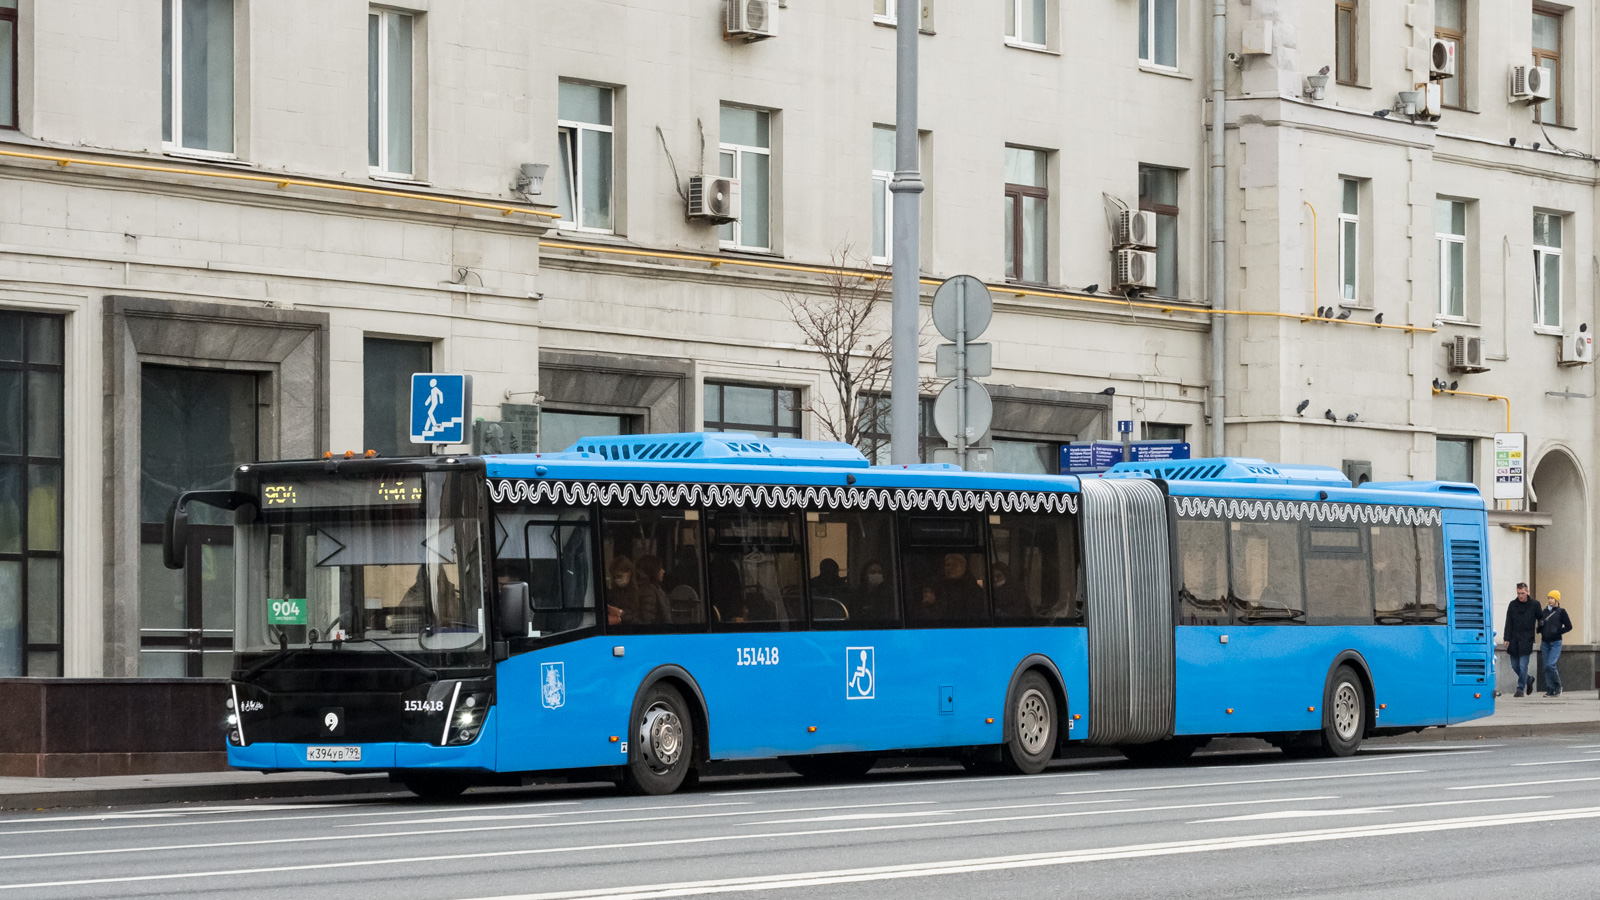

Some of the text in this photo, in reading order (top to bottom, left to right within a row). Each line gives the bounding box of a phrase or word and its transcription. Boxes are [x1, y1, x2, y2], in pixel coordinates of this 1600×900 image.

[272, 601, 300, 616] 904
[736, 646, 779, 666] 151418
[404, 700, 444, 711] 151418
